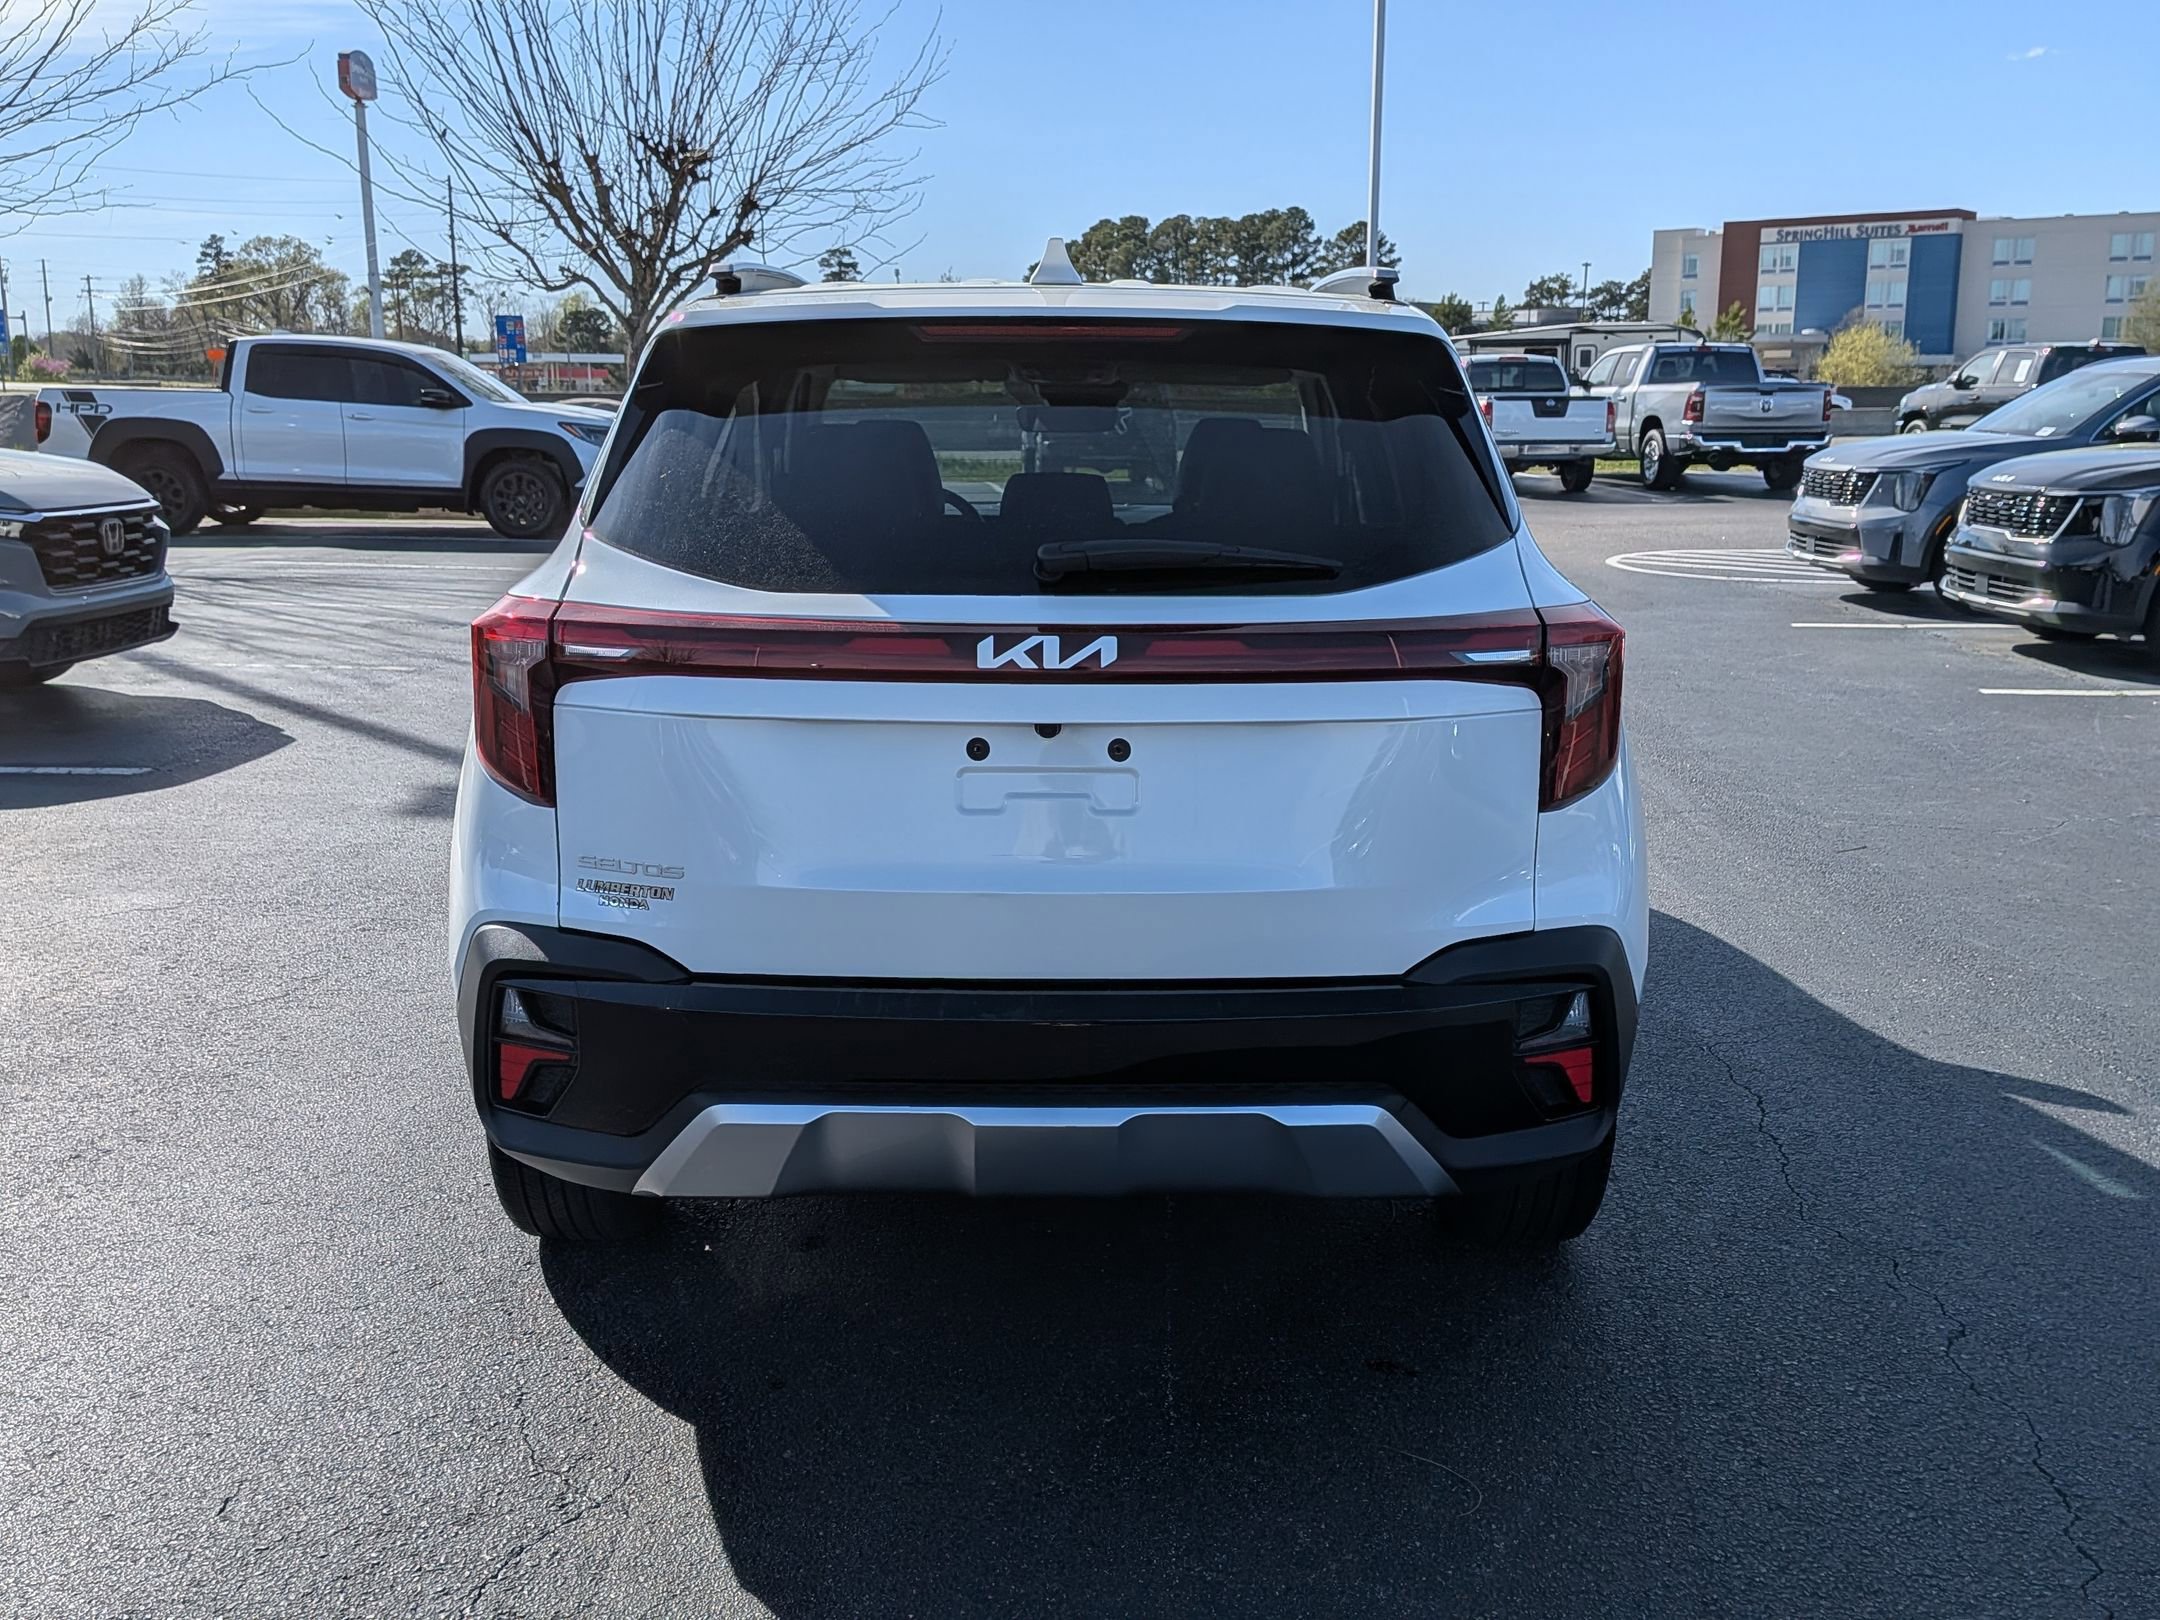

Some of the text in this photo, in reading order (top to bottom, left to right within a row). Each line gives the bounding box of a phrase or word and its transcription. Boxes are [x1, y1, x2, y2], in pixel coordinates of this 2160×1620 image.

[1856, 223, 1902, 239] SUITES
[56, 403, 113, 415] HPD
[977, 635, 1118, 669] KIA
[577, 855, 686, 880] SELTOS
[576, 878, 675, 901] LUMBERTON
[598, 894, 650, 911] HONDA
